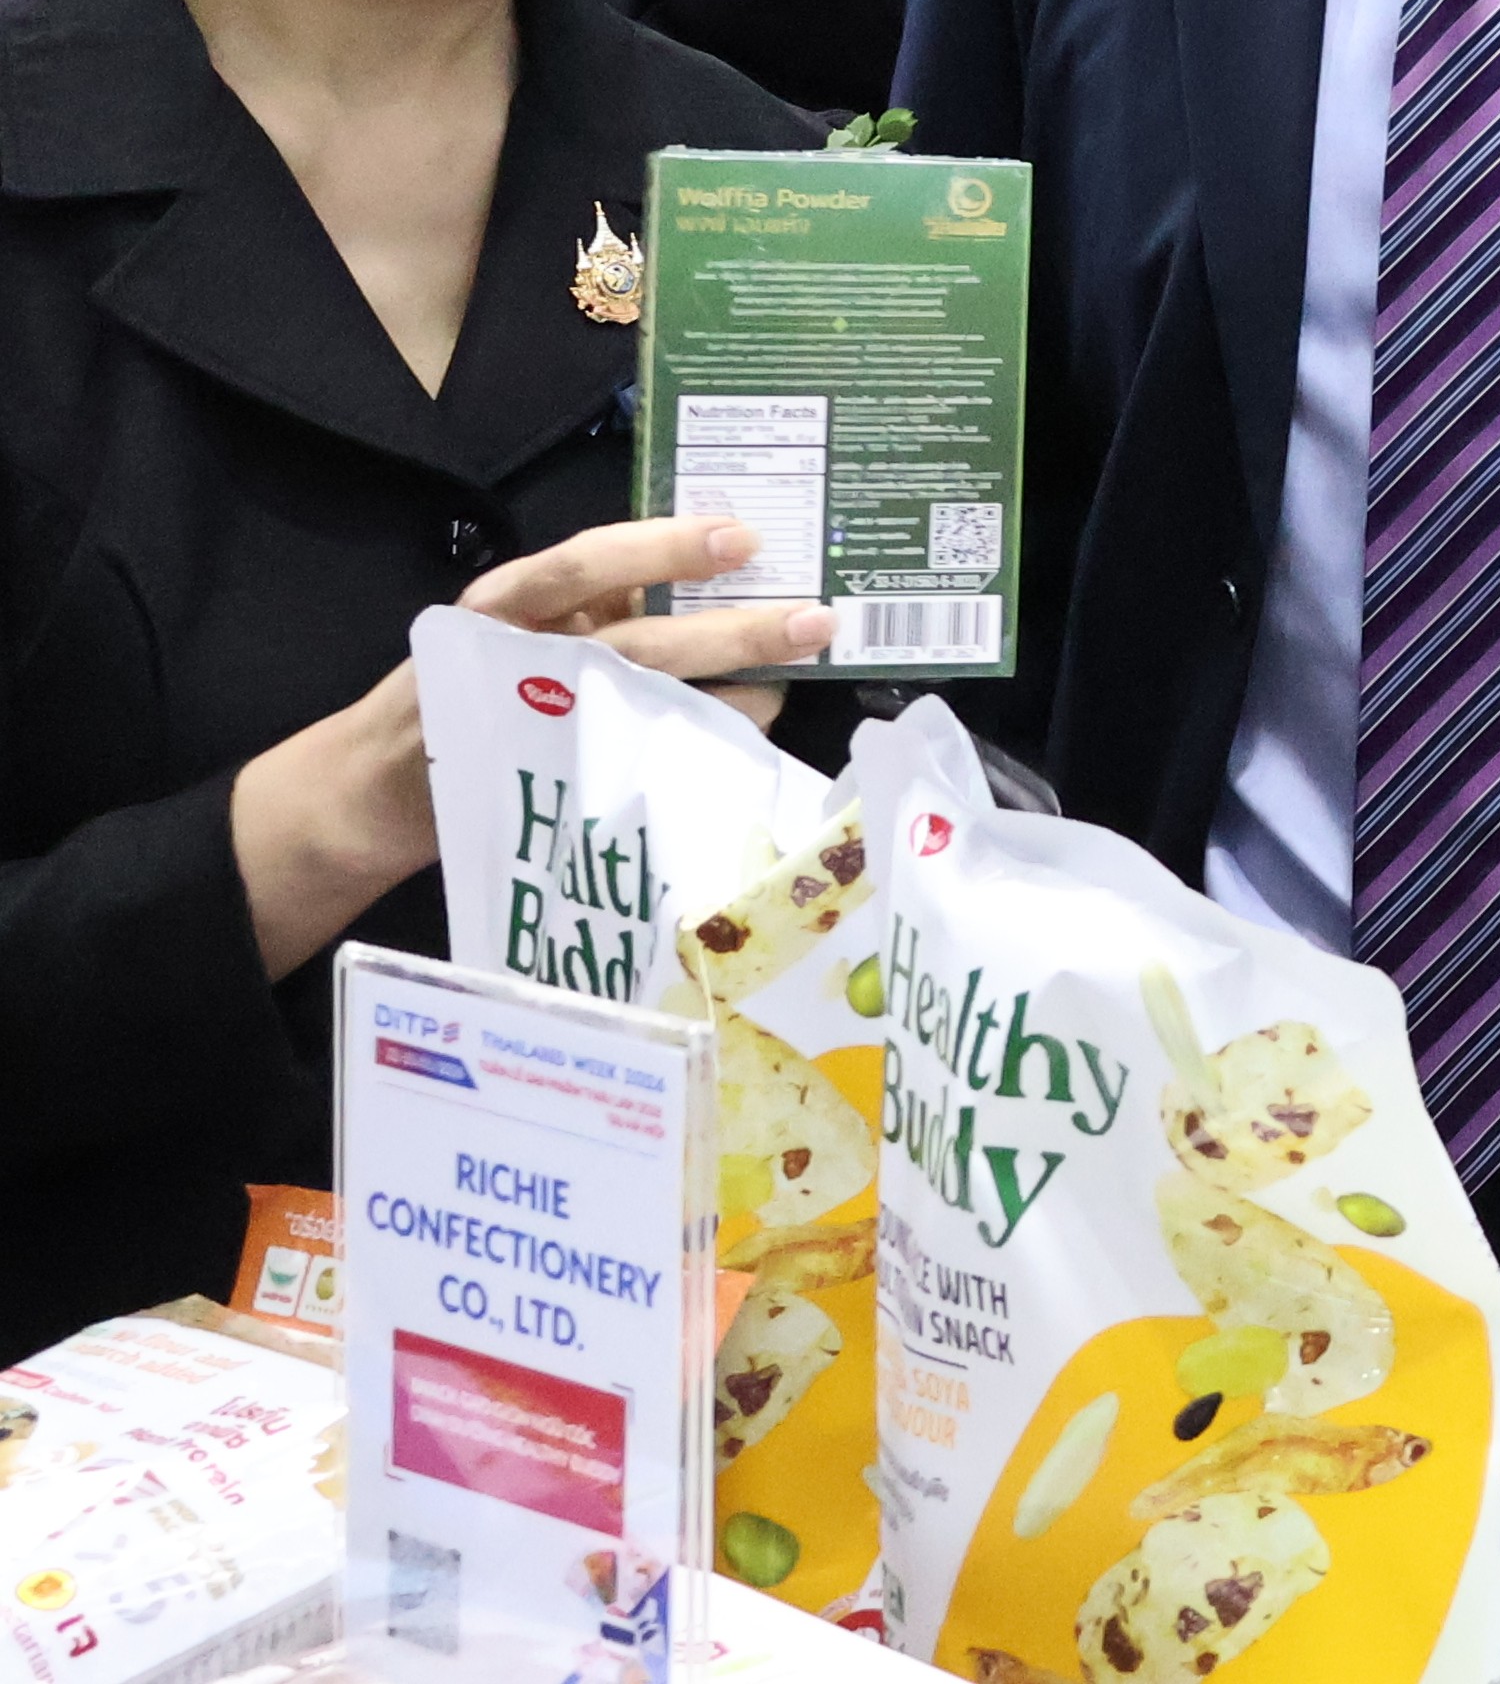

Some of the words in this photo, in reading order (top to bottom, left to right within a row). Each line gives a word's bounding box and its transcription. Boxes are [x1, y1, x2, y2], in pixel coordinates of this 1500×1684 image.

[887, 912, 1130, 1136] Healthy
[881, 1036, 1066, 1248] Buddy
[455, 1152, 571, 1220] RICHIE
[366, 1190, 662, 1309] CONFECTIONERY
[438, 1273, 505, 1333] CO.,
[514, 1293, 586, 1352] LTD.
[936, 1261, 1010, 1320] WITH
[928, 1310, 1015, 1366] SNACK
